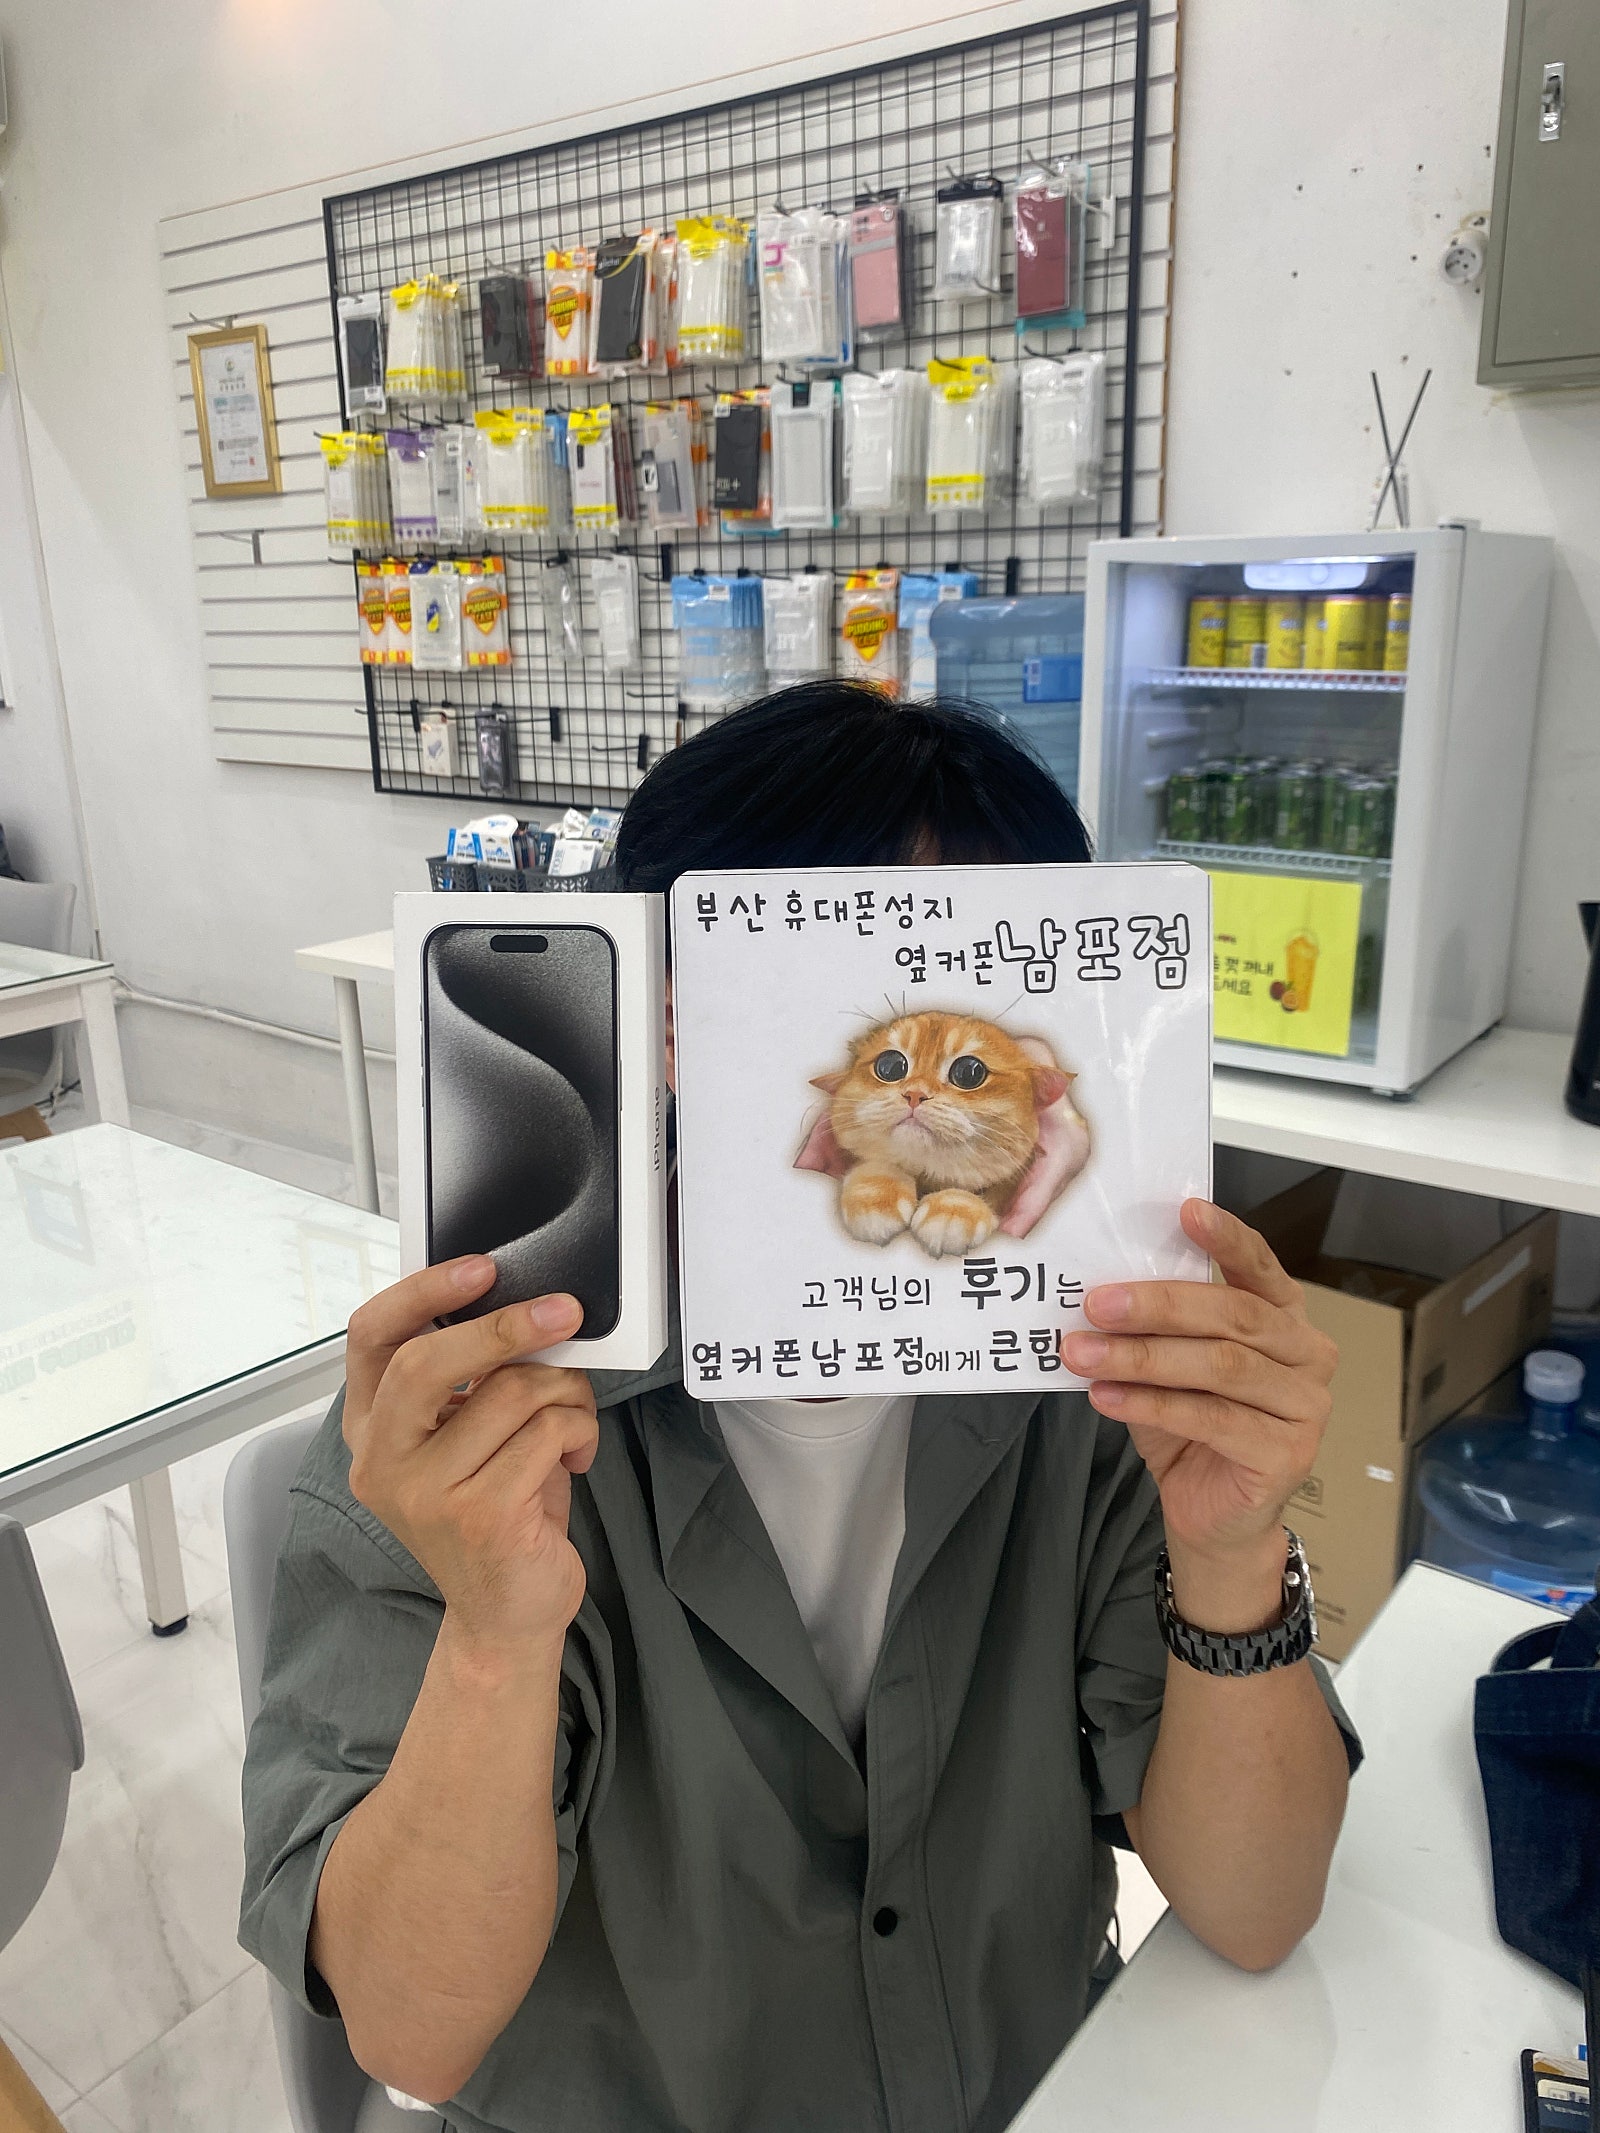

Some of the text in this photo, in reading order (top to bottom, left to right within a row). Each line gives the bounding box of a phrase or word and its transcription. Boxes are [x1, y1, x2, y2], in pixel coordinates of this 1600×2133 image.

[696, 889, 953, 937] 부산 휴대폰성지
[802, 1257, 1084, 1312] 고객님의 후기는
